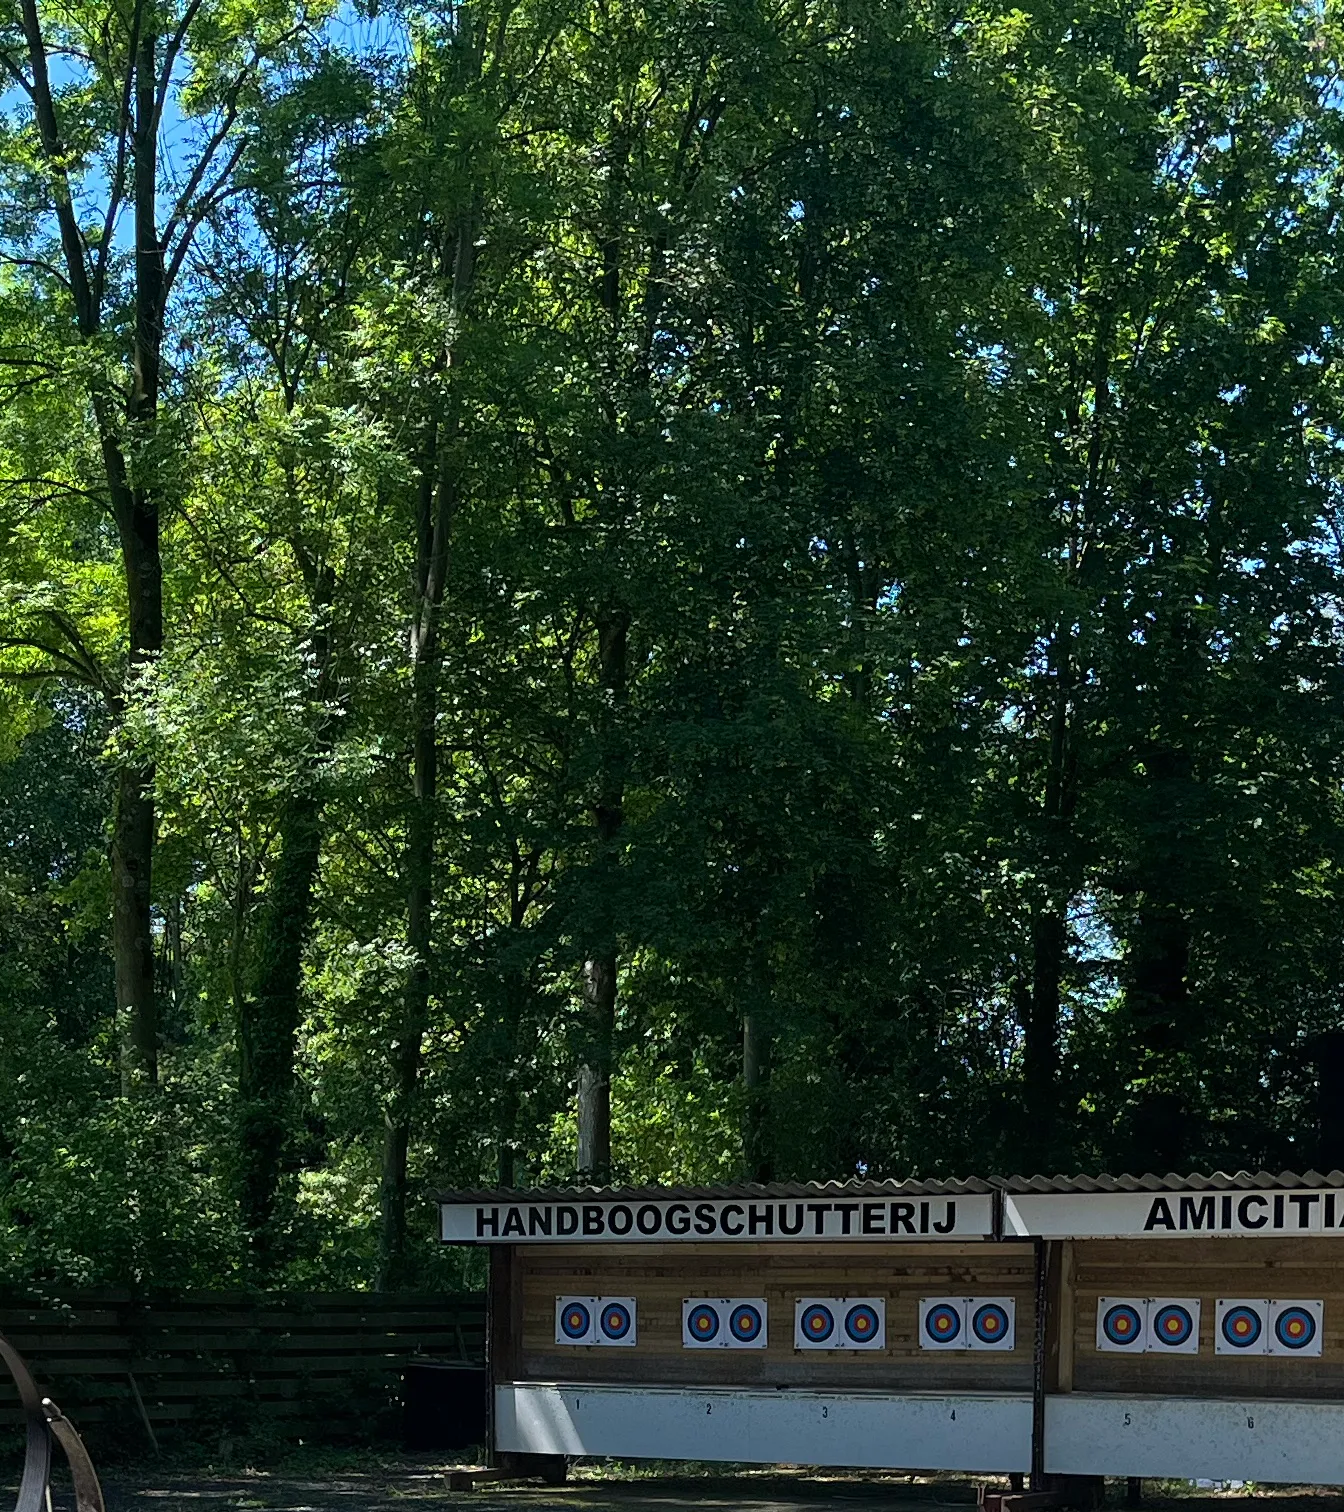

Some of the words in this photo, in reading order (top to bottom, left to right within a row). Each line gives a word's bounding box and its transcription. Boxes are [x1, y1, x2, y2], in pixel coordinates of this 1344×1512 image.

[475, 1201, 957, 1238] HANDBOOGSCHUTTERIJ
[706, 1402, 712, 1415] 2
[822, 1405, 828, 1419] 3
[950, 1409, 956, 1422] 4
[1122, 1412, 1131, 1427] 5
[1246, 1416, 1255, 1430] 6
